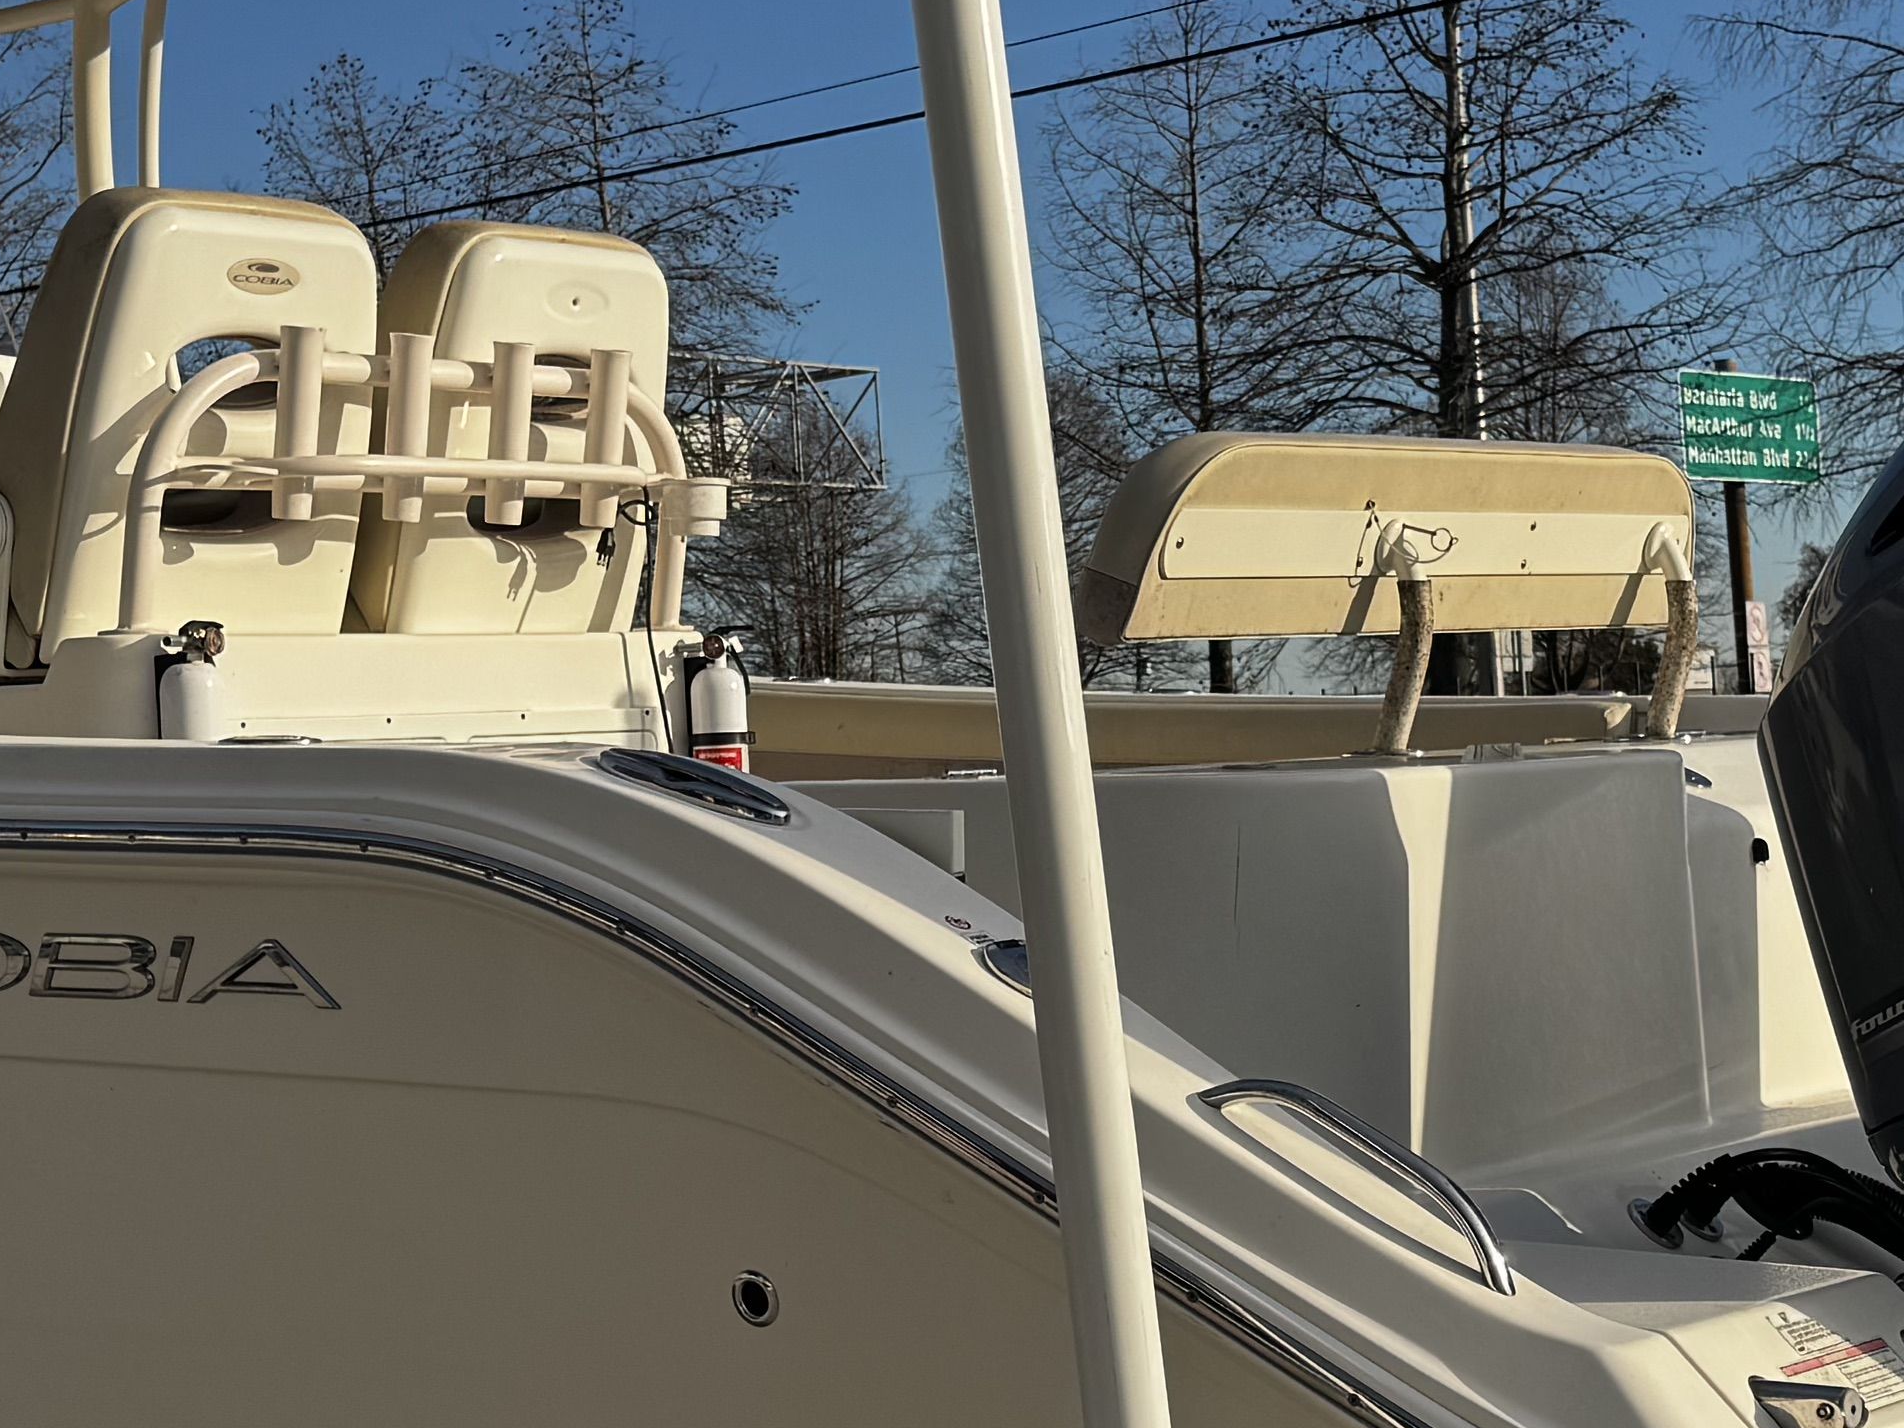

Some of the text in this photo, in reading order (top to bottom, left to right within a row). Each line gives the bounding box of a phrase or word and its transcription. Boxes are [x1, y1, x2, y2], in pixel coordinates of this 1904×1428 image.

[233, 274, 295, 287] COBIA
[1749, 390, 1777, 411] Blvd
[1686, 415, 1753, 439] MacArthur
[1760, 422, 1782, 440] Ave
[1688, 446, 1757, 467] Manhattan
[1763, 448, 1790, 468] Blvd
